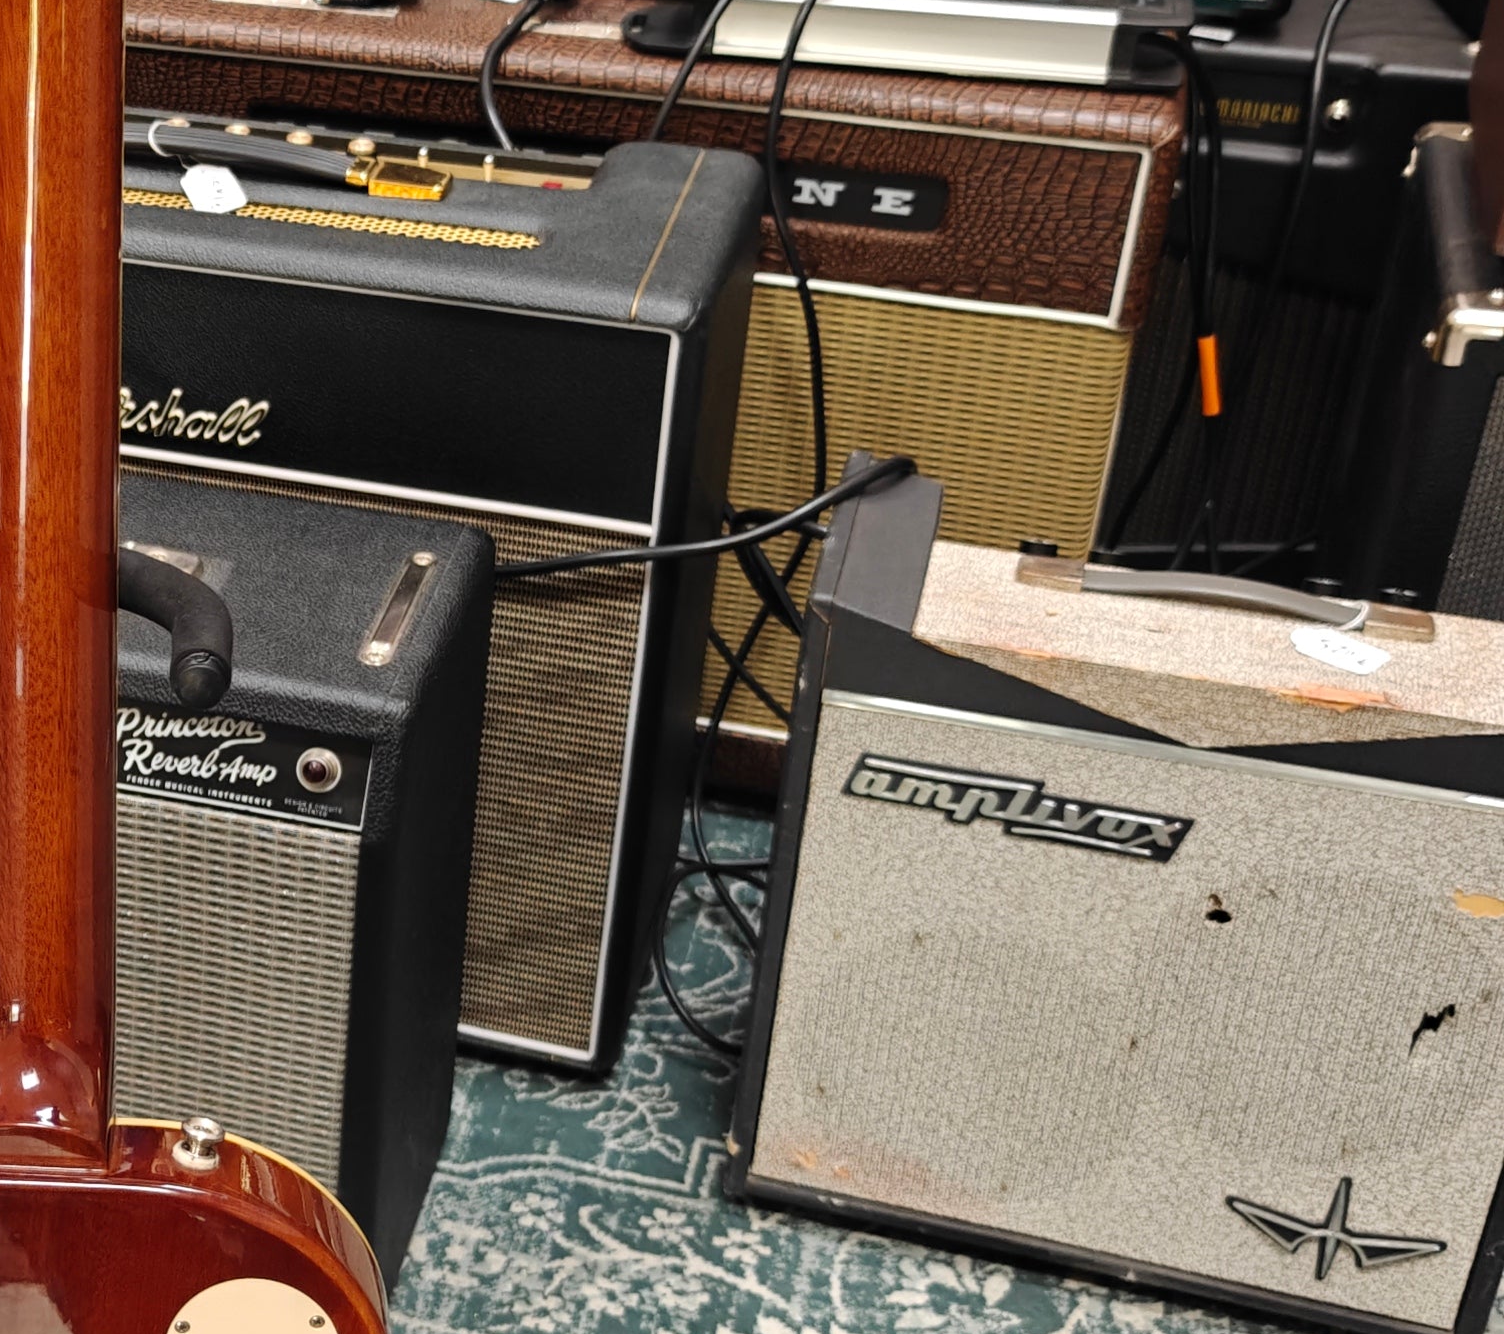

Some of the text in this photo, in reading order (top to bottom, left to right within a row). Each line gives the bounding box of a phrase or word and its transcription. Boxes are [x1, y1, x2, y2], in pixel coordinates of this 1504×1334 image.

[120, 386, 271, 447] rshall
[117, 707, 266, 741] Princeton
[121, 738, 277, 787] Reverb-Amp
[126, 774, 273, 808] FENDER MUSICAL INSTRUMENTS
[848, 768, 1184, 849] amplivox
